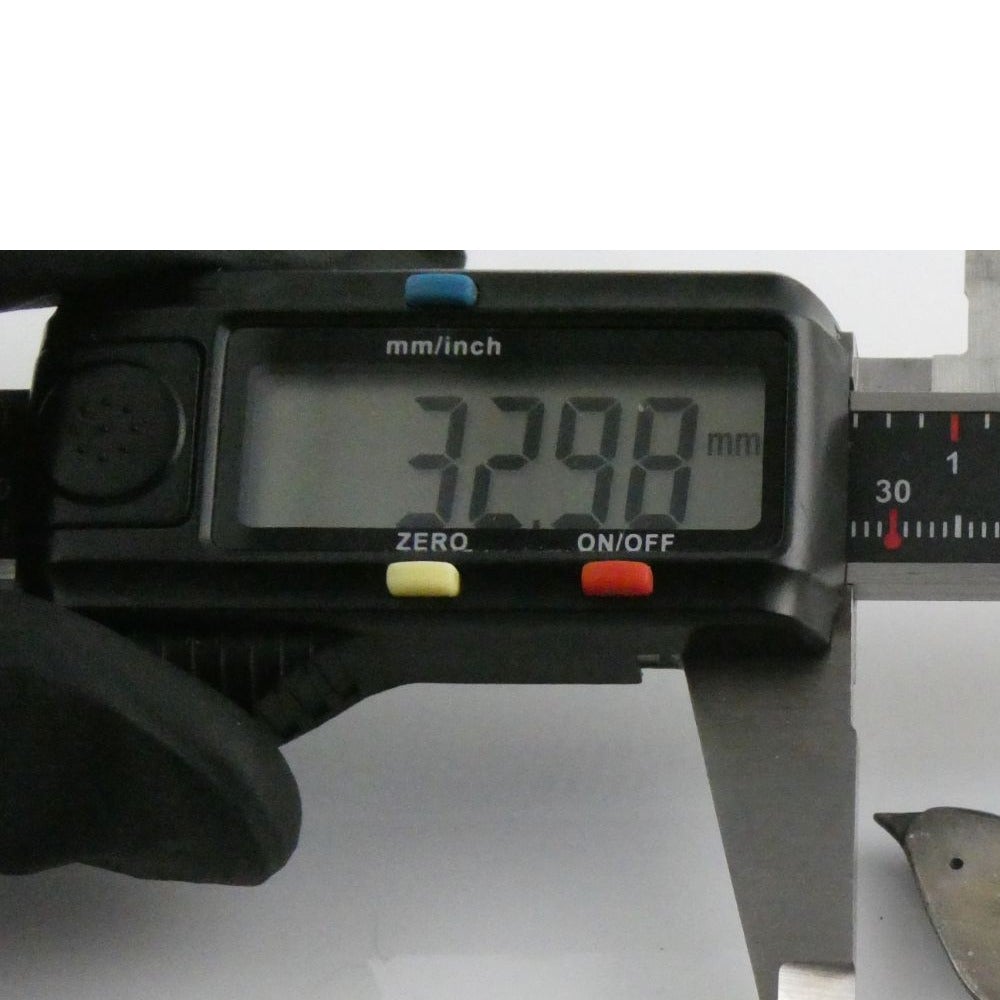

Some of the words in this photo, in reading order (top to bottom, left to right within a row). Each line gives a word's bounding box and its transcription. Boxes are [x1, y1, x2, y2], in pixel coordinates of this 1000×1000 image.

[386, 335, 501, 356] mm/inch
[707, 431, 761, 457] mm
[945, 450, 960, 475] 1
[875, 479, 911, 504] 30
[395, 532, 470, 553] ZERO
[577, 532, 675, 553] ON/OFF
